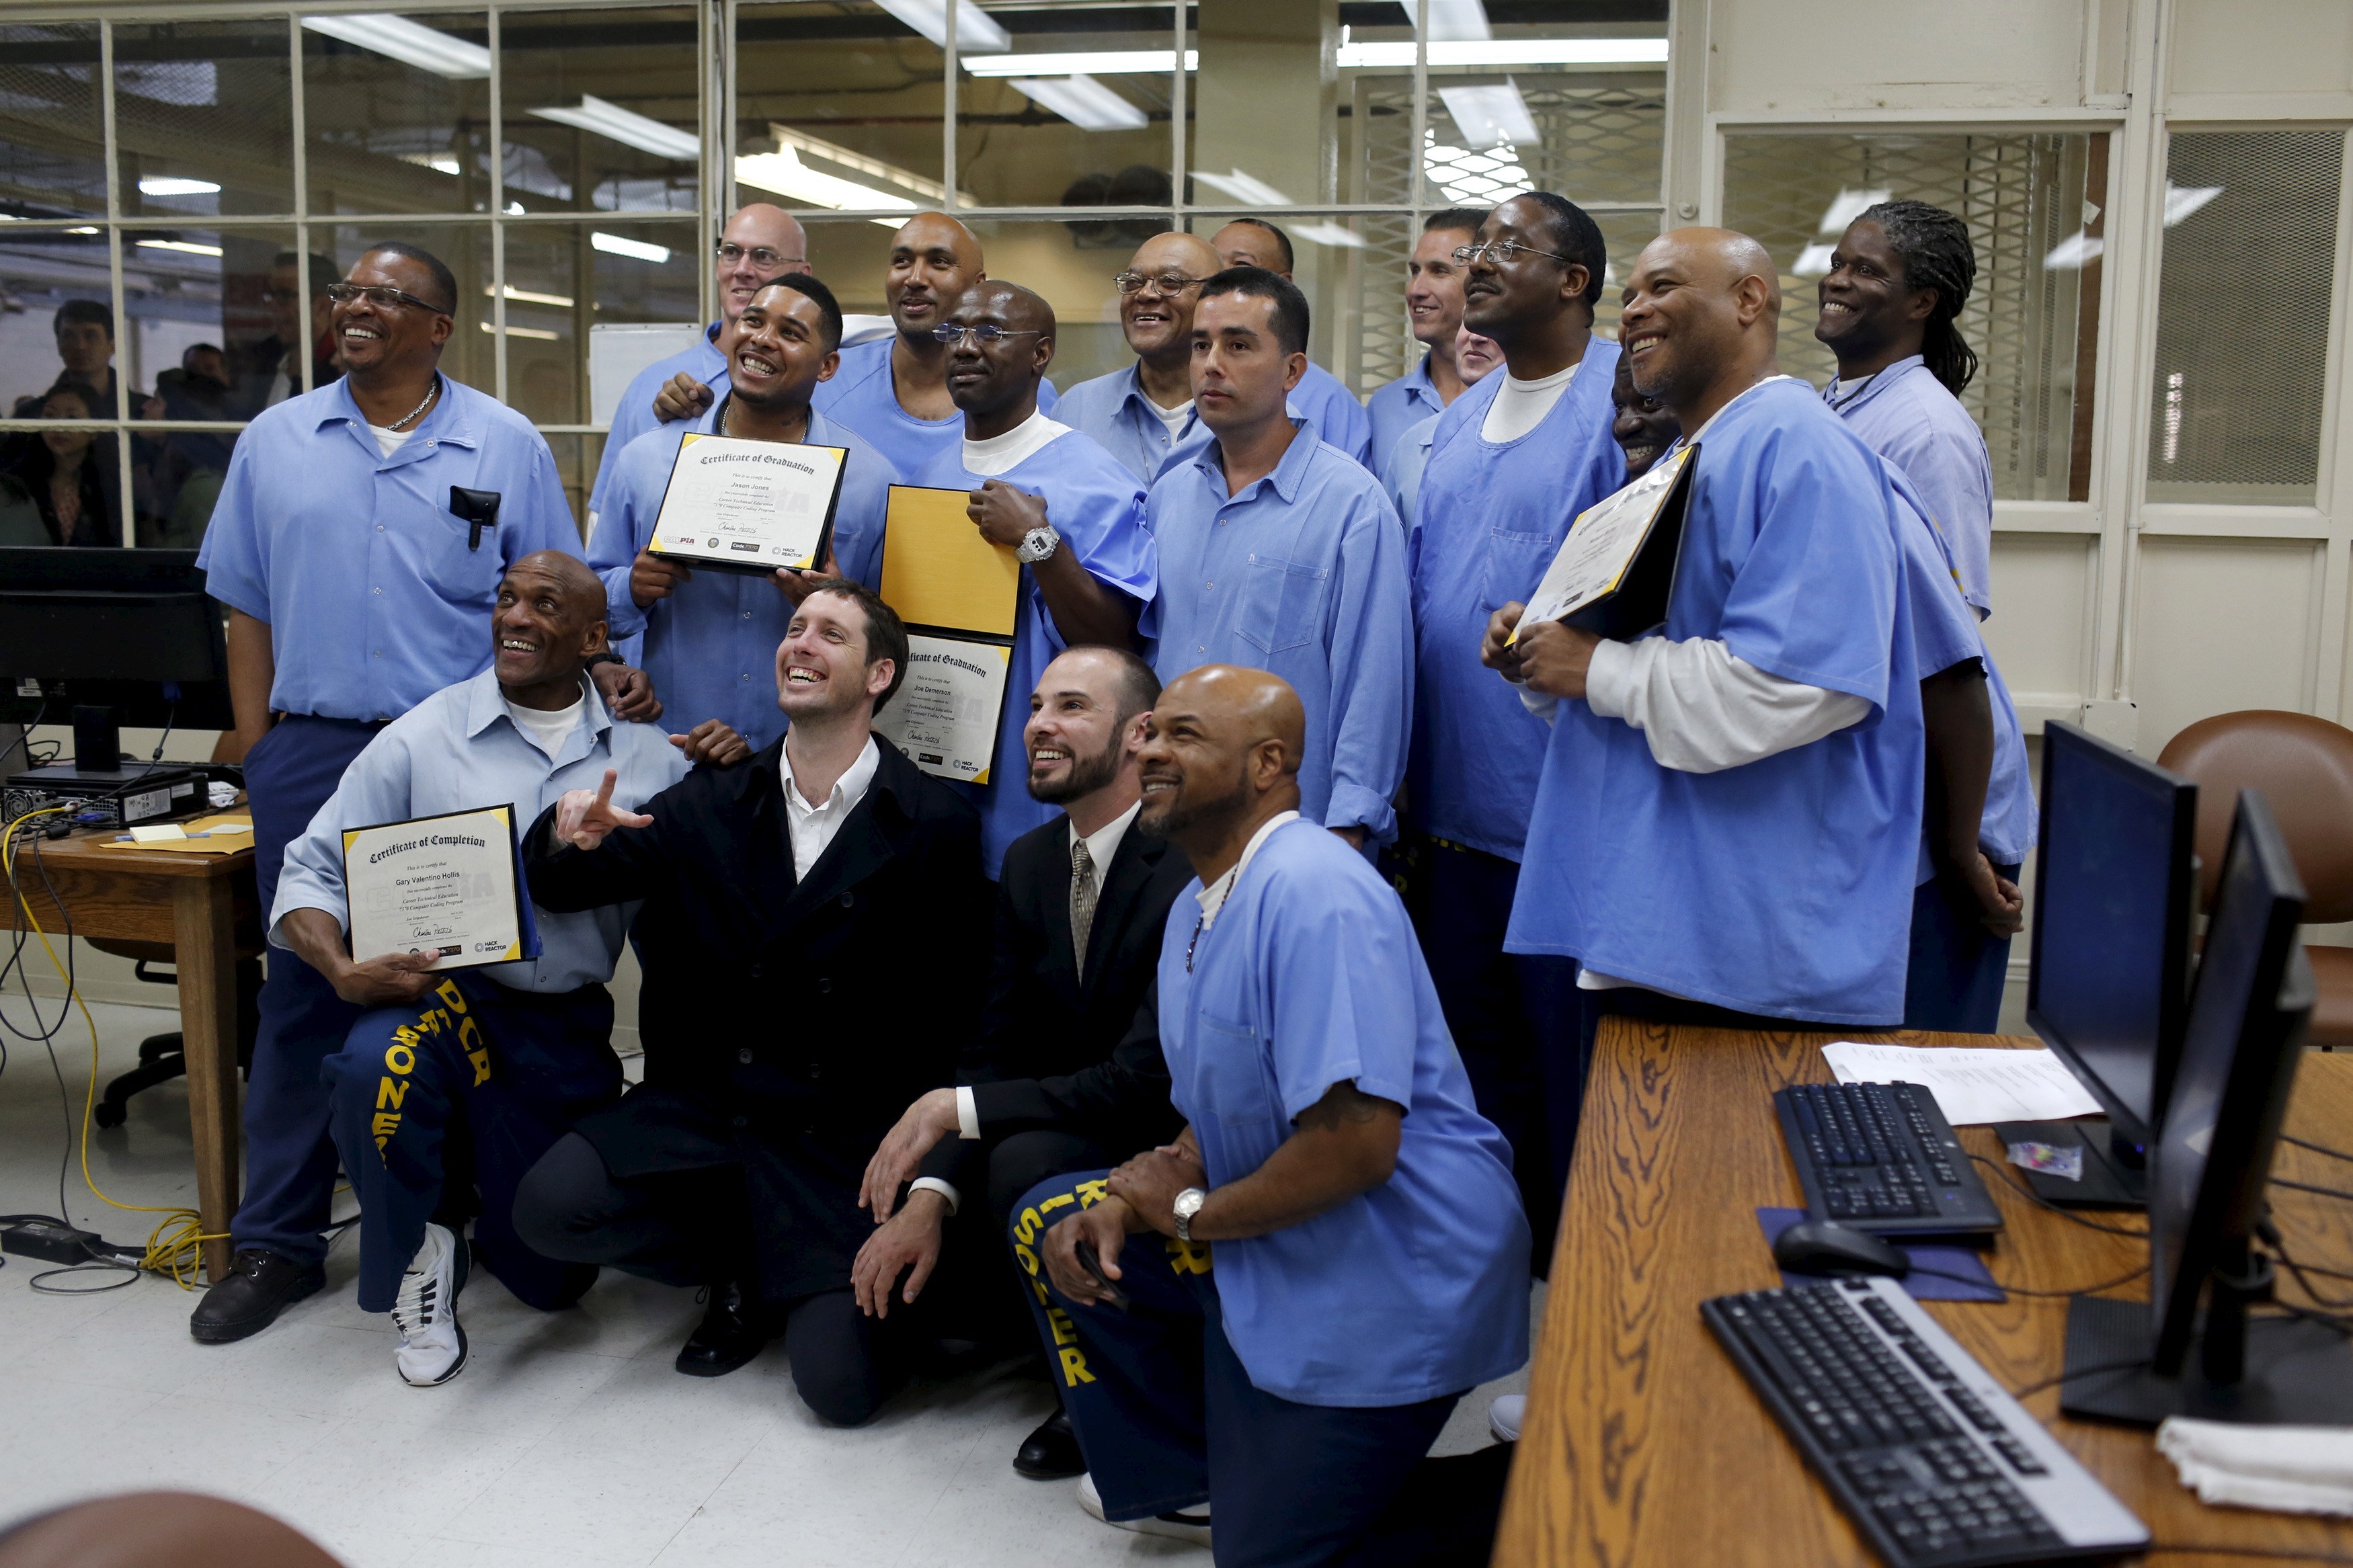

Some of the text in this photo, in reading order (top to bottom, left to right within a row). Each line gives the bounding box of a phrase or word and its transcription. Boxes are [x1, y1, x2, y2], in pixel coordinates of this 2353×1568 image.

[701, 454, 815, 475] Certificate of Graduation
[909, 653, 986, 677] ficate of Graduation
[924, 686, 951, 696] Demerson
[369, 834, 485, 864] Certificate of Completion
[411, 874, 441, 883] Valentino
